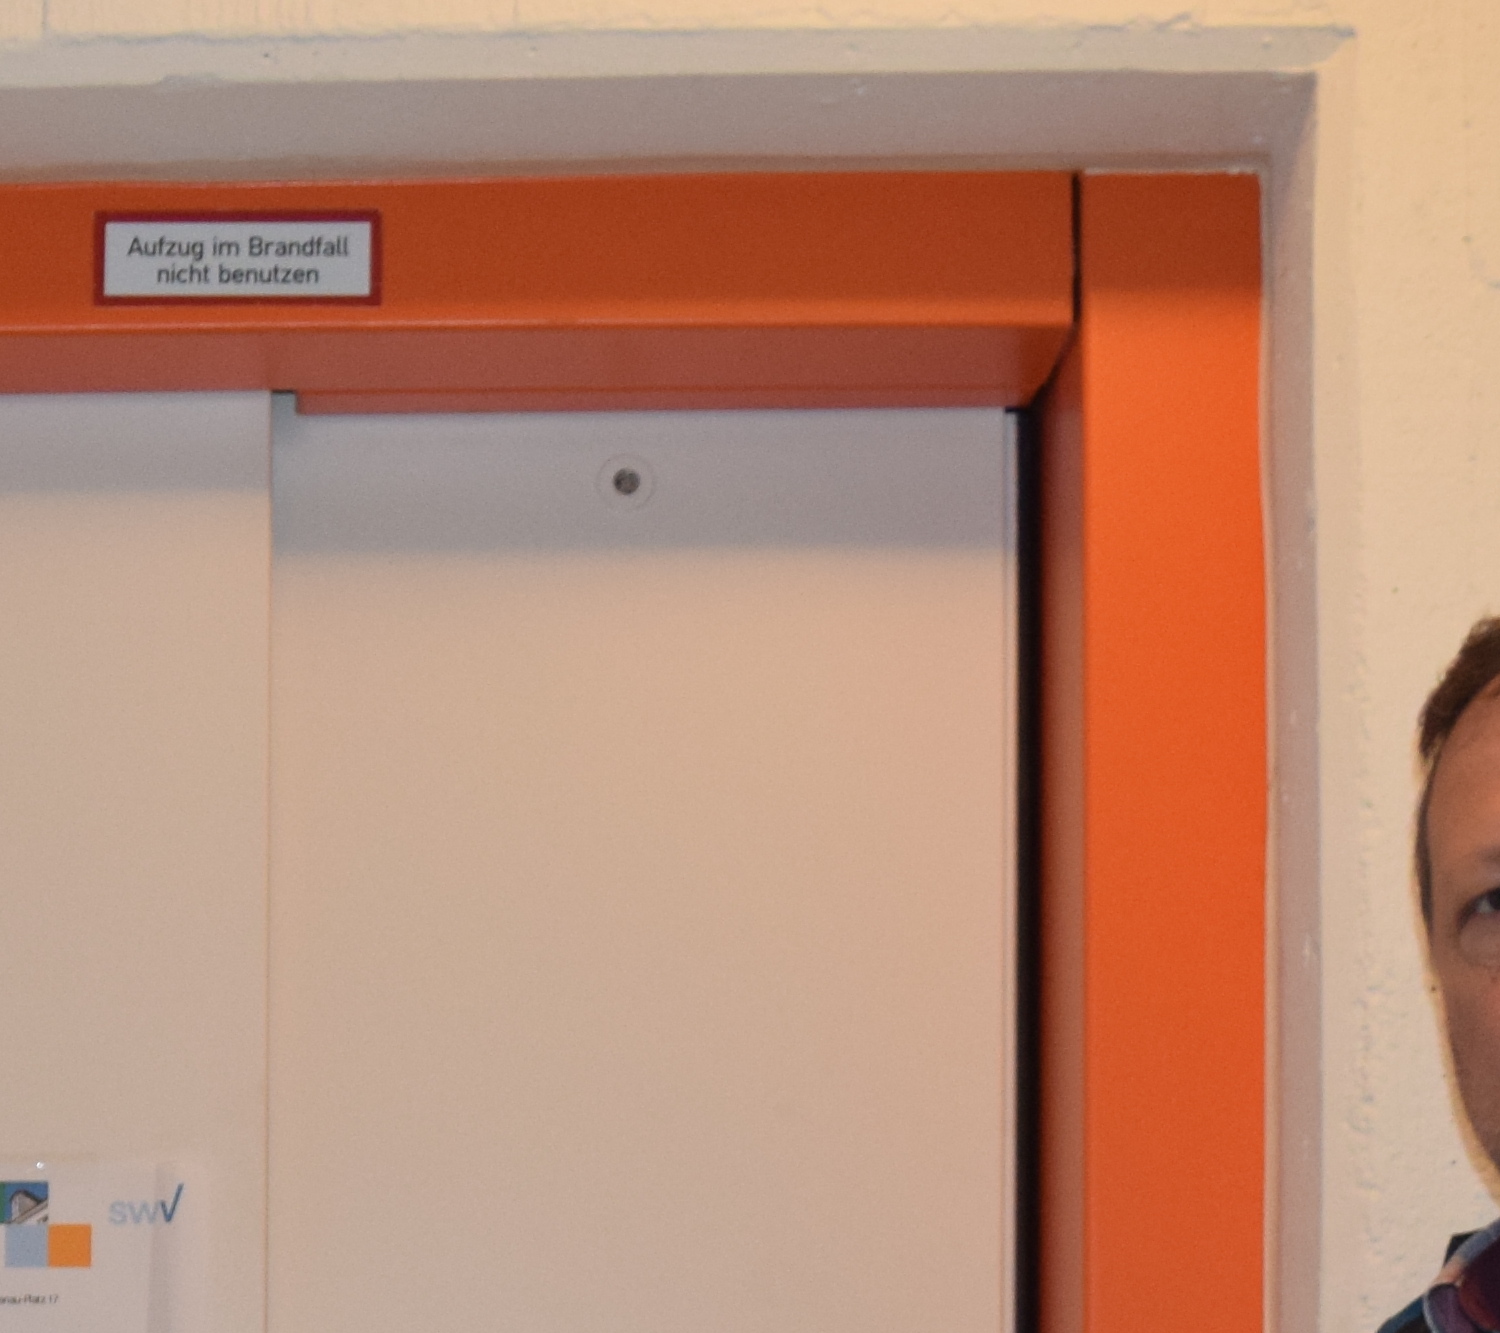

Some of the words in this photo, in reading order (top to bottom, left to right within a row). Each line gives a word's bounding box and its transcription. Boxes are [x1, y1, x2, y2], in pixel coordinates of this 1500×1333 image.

[127, 235, 204, 262] Aufzug
[212, 236, 240, 258] im
[248, 235, 349, 258] Brandfall
[157, 264, 210, 284] nicht
[218, 264, 320, 284] benutzen
